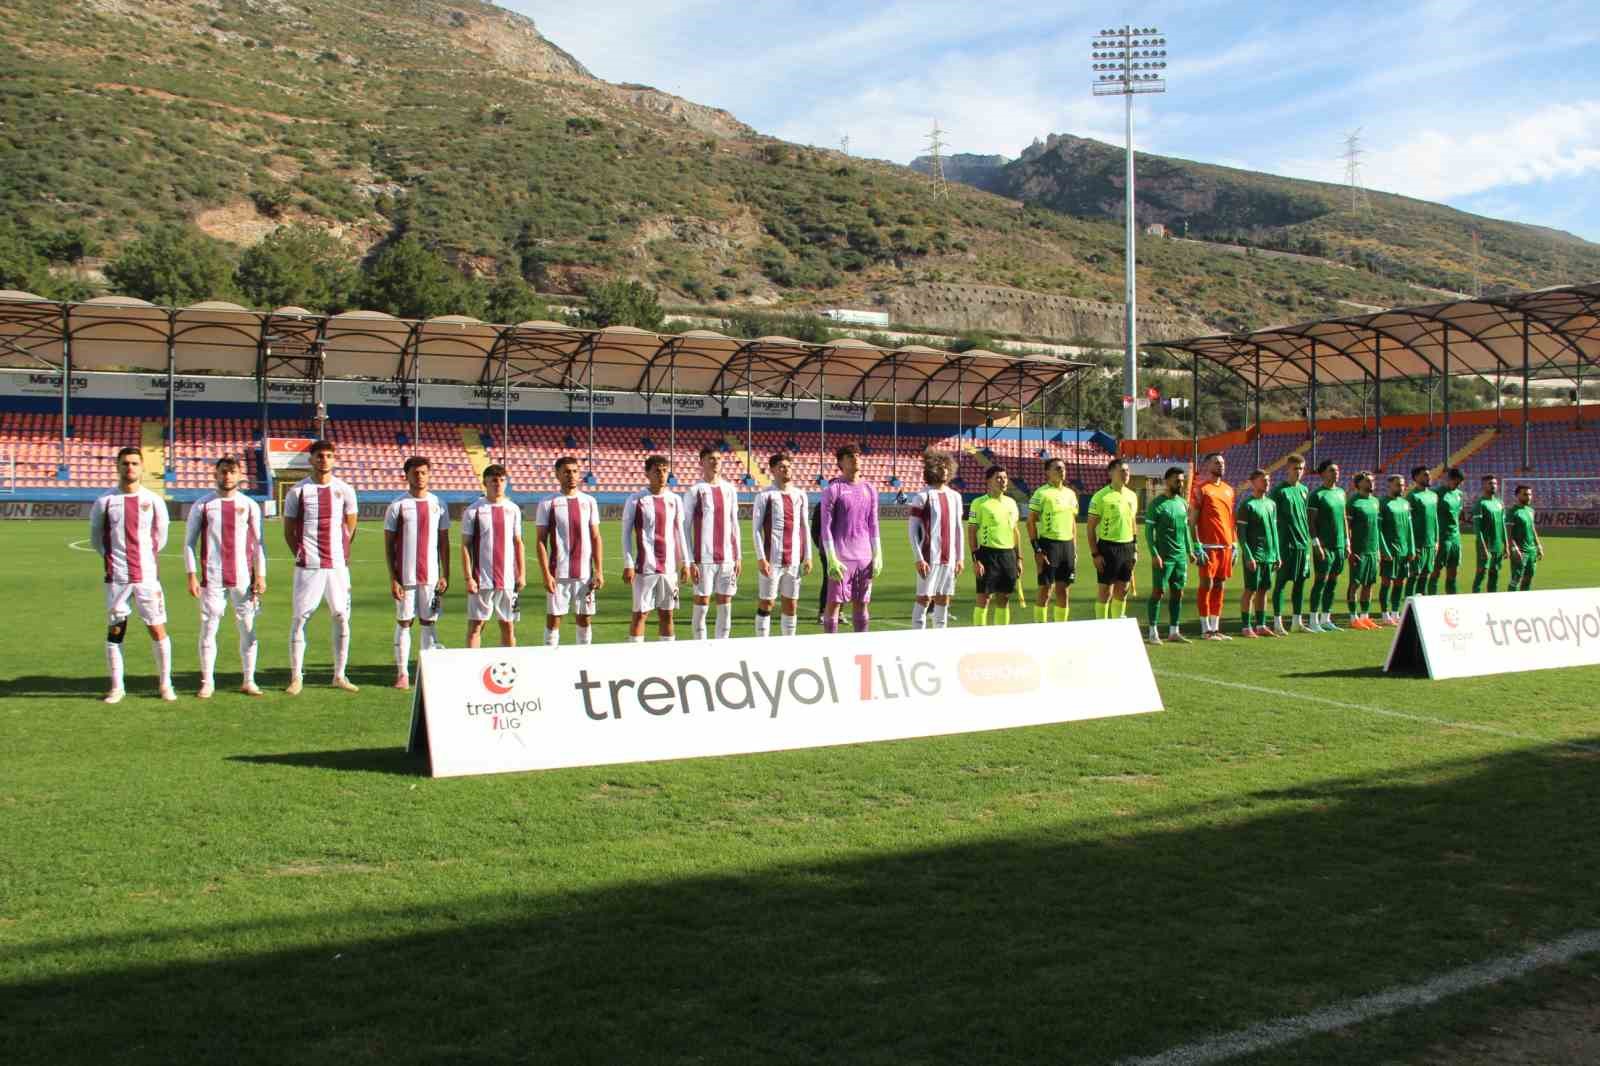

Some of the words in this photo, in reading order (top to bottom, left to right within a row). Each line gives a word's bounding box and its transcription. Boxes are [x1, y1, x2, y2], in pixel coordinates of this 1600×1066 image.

[30, 374, 87, 388] Mingng
[0, 503, 27, 516] UN
[574, 656, 839, 720] trendyol
[466, 697, 542, 716] trendyol
